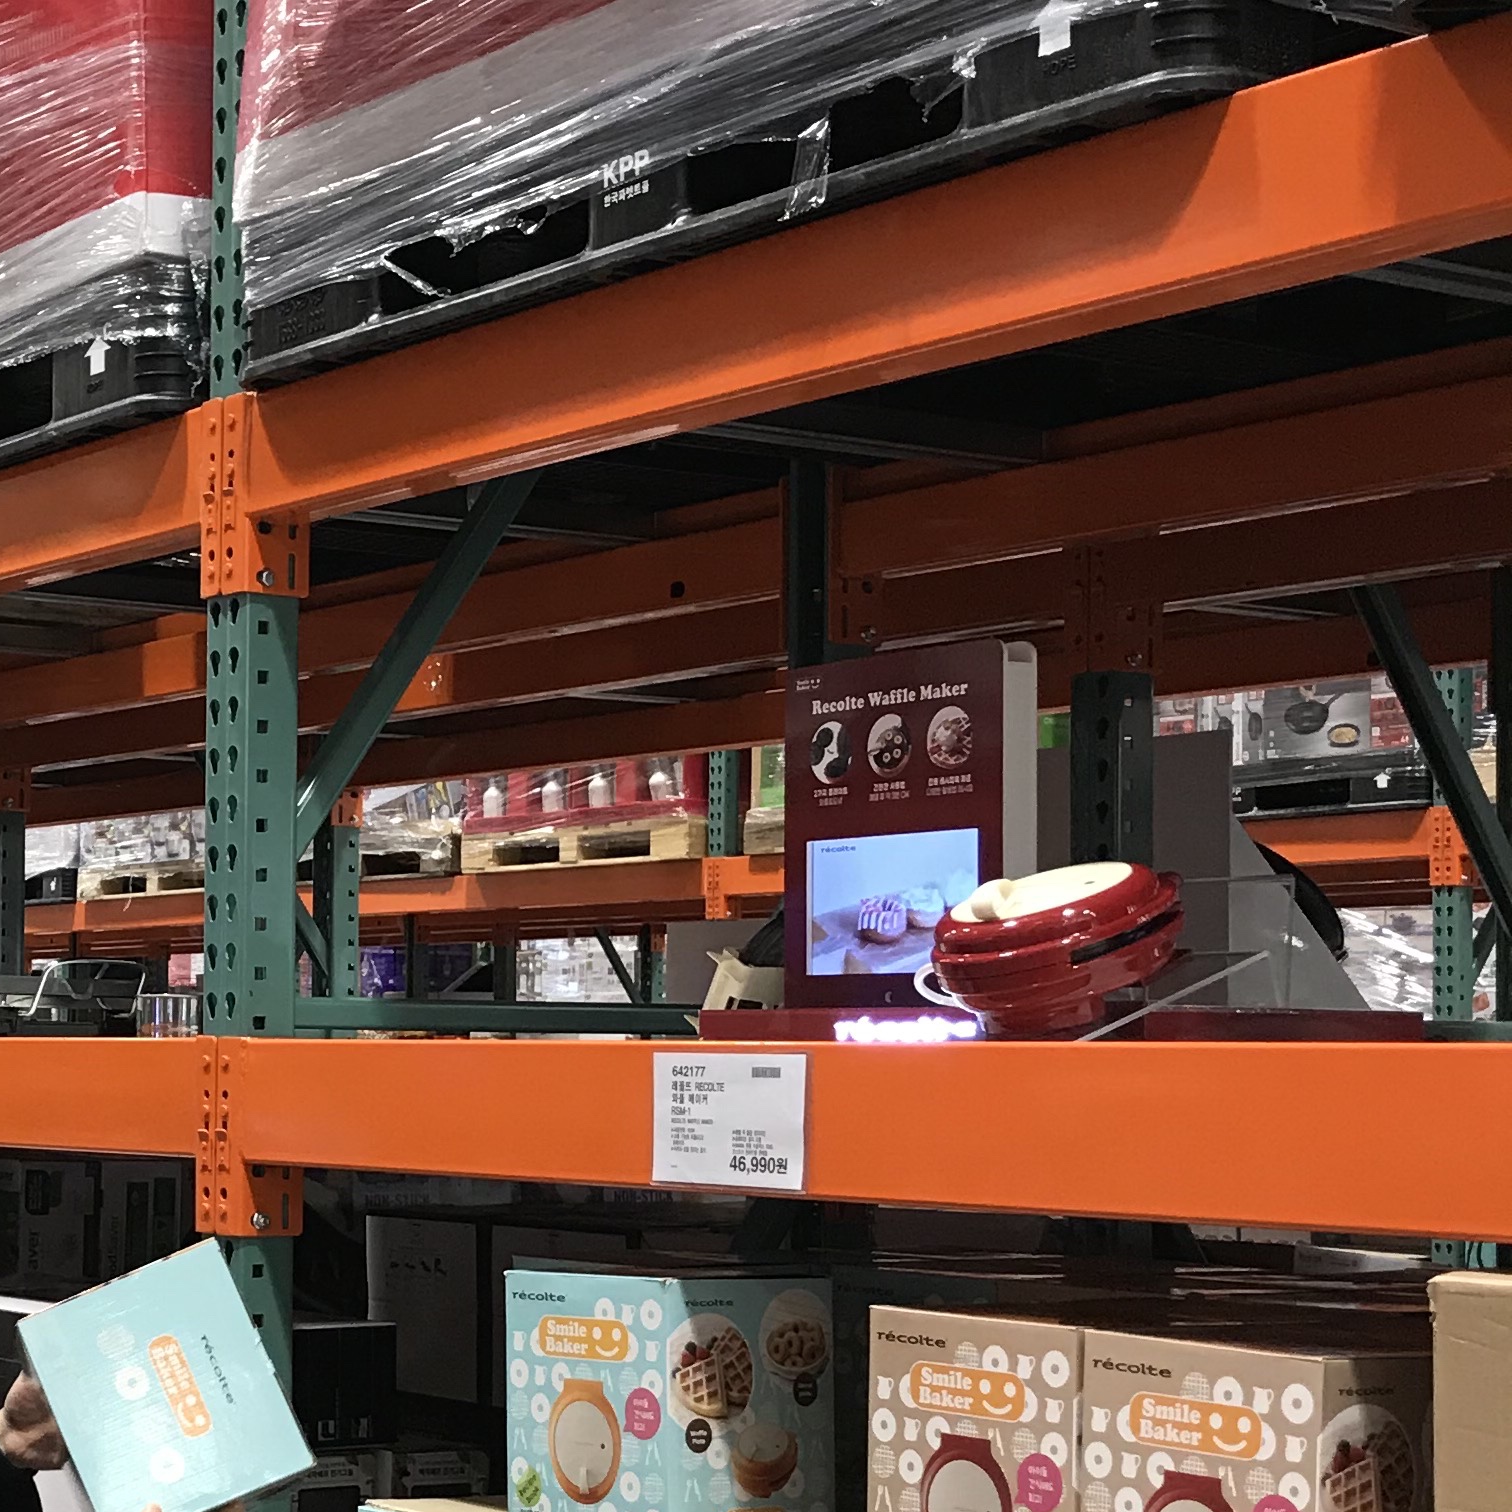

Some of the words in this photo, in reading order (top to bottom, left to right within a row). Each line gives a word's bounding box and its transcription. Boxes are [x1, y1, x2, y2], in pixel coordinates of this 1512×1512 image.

[602, 150, 650, 186] KPP
[812, 696, 864, 714] Recolte
[868, 688, 915, 706] Waffle
[920, 682, 968, 700] Maker
[672, 1066, 705, 1077] 642177
[730, 1156, 787, 1175] 46,990원
[512, 1289, 566, 1302] récolte
[547, 1320, 587, 1338] Smile
[877, 1330, 946, 1348] récolte
[545, 1338, 588, 1355] Baker
[151, 1348, 178, 1396] Baker
[165, 1341, 190, 1389] Smile
[201, 1334, 233, 1404] récolte
[1093, 1358, 1172, 1378] récolte
[921, 1367, 972, 1390] Smile
[919, 1387, 973, 1411] Baker
[1142, 1399, 1200, 1424] Smile
[1139, 1420, 1202, 1446] Baker
